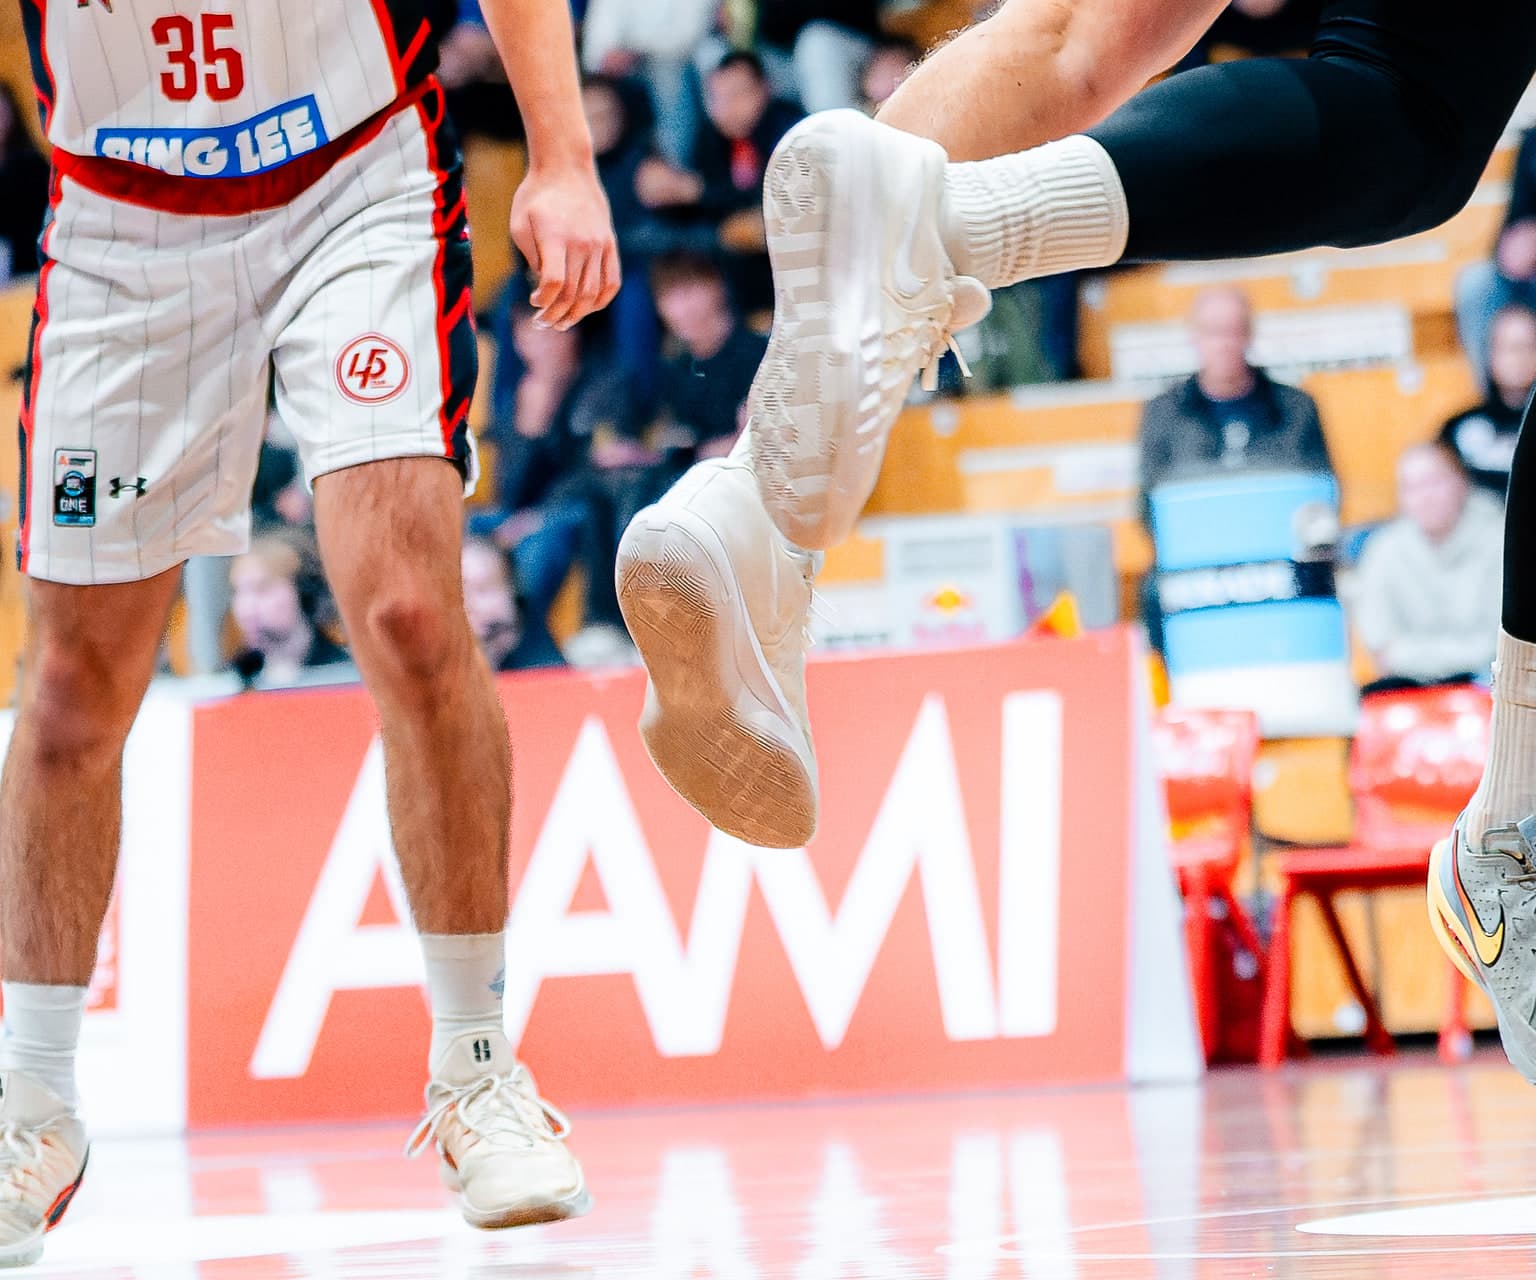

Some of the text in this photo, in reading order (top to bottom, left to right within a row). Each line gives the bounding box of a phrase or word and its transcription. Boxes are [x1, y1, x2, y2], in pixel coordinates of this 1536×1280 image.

[150, 11, 245, 104] 35
[235, 104, 318, 174] LEE
[346, 347, 389, 390] 45
[248, 687, 1064, 1081] AAMI
